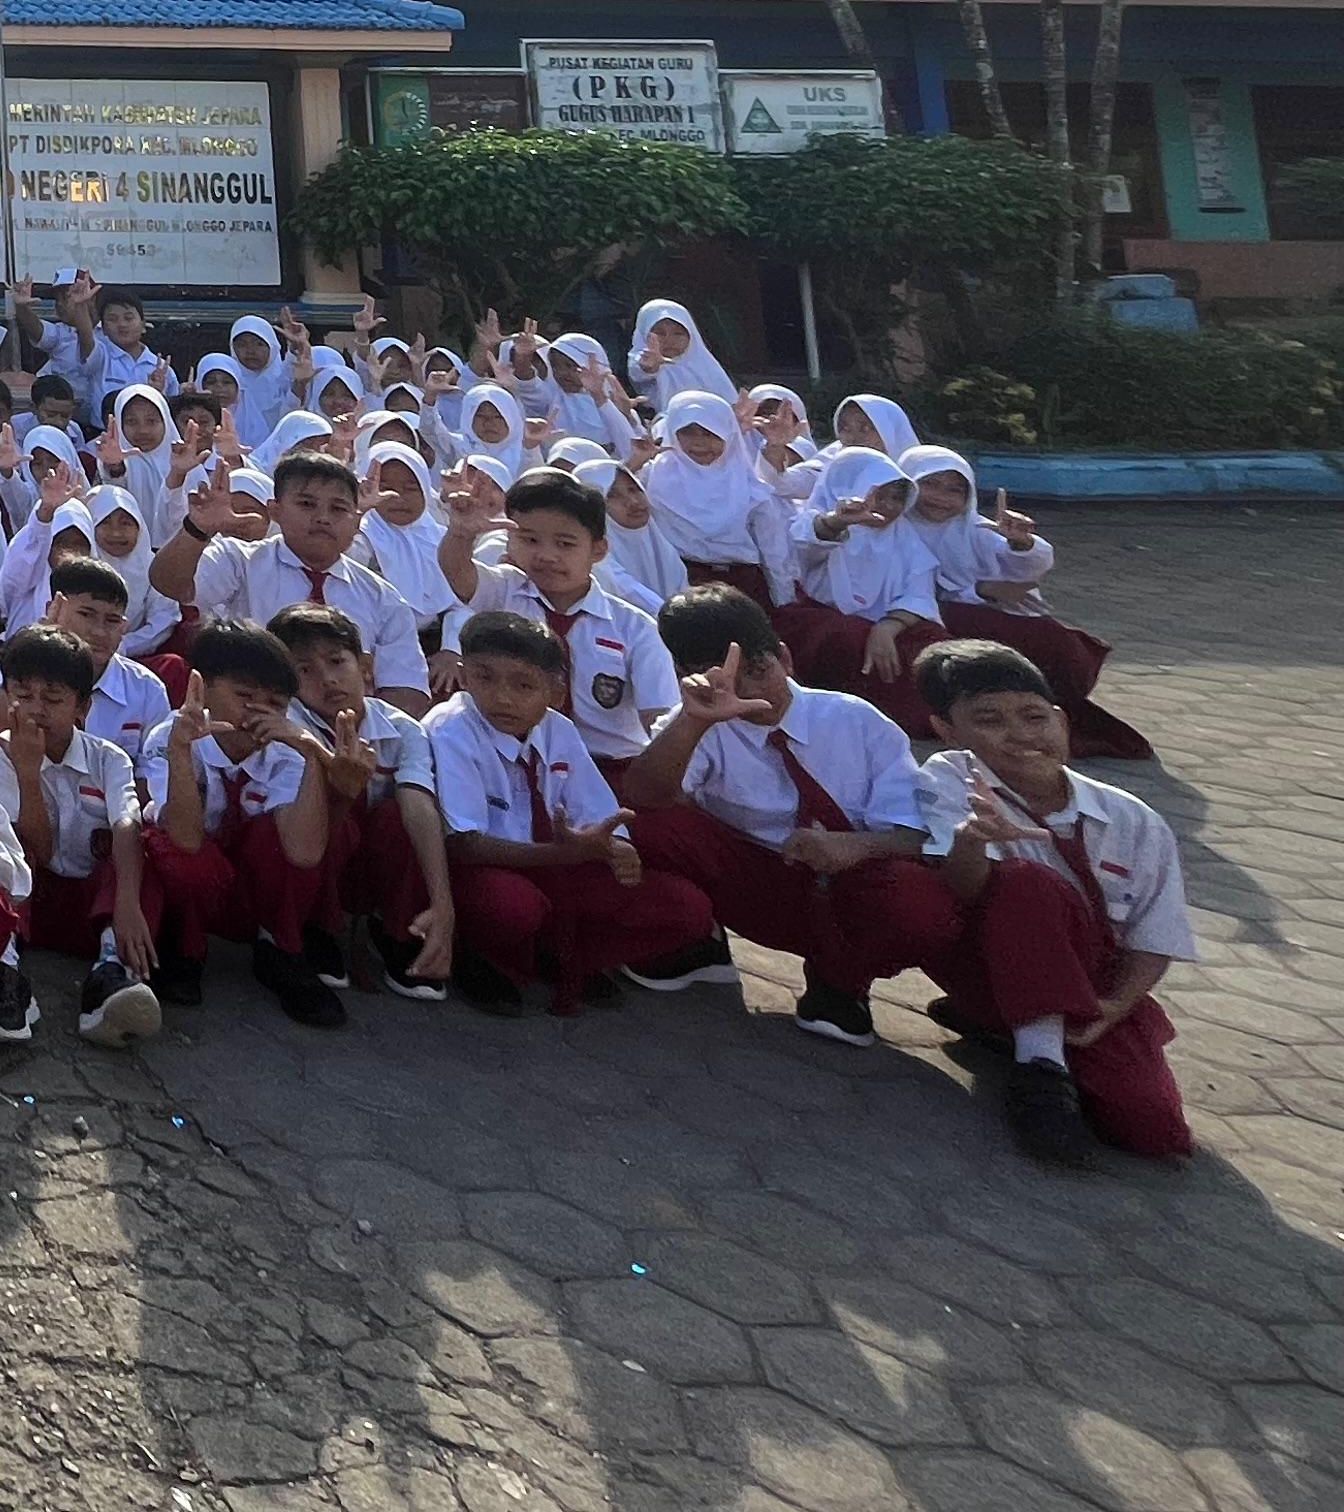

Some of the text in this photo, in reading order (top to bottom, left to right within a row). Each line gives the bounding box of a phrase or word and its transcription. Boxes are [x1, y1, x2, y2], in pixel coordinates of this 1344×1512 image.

[549, 57, 693, 70] PUSAT KEGIATAN GURU
[803, 87, 846, 102] UKS
[201, 105, 262, 125] JEPARA
[559, 104, 606, 122] GUGUS
[611, 104, 683, 123] HARAPAN
[640, 129, 705, 142] MLONGGO
[35, 135, 136, 155] DISDIKPORA
[20, 170, 109, 203] NEGERI
[115, 171, 129, 202] 4
[137, 170, 272, 205] SINANGGUL
[229, 220, 272, 232] JEPARA
